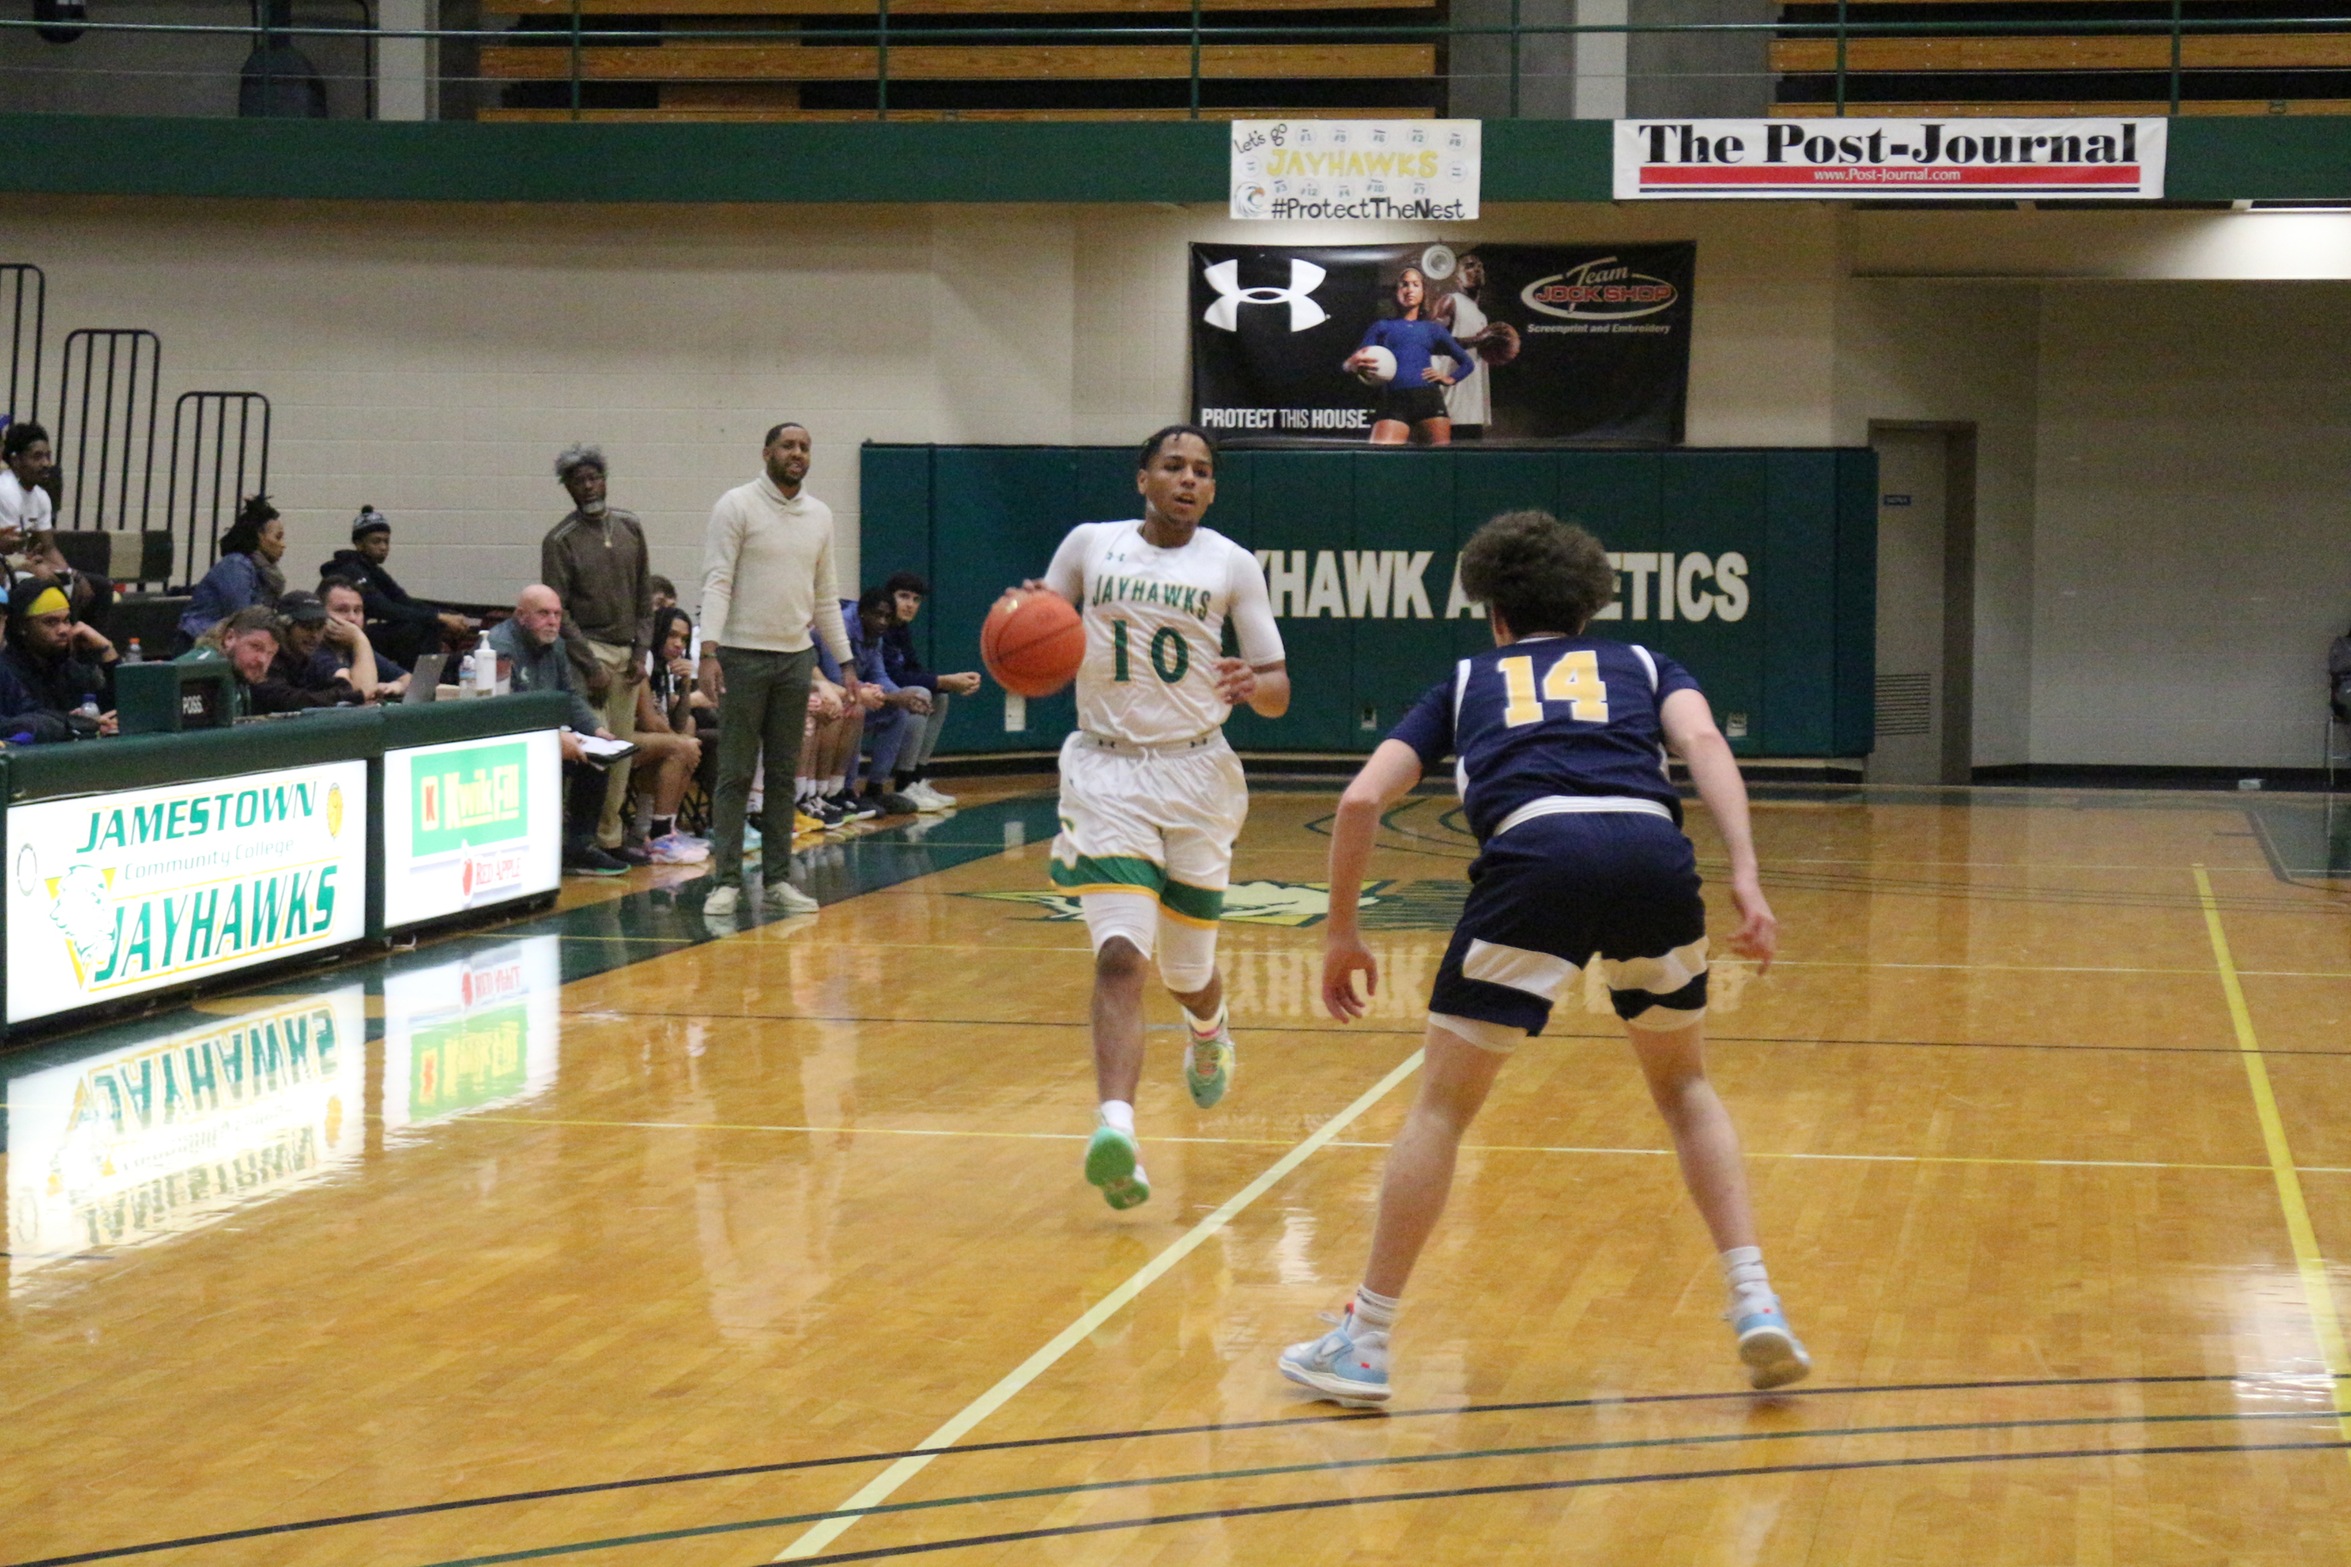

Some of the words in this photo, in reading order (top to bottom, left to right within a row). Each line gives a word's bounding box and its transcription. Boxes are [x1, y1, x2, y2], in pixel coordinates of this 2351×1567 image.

[1270, 123, 1288, 147] go
[1638, 123, 1745, 164] The
[1762, 122, 2139, 164] Post-Journal
[1266, 148, 1439, 179] JAYHAWKS
[1813, 168, 1961, 182] www.Post-Journal.com
[1271, 196, 1465, 219] #ProtectTheNest
[1566, 256, 1629, 288] Team
[1534, 284, 1602, 303] JOCK
[1603, 284, 1672, 303] SHOP
[1527, 323, 1588, 335] Screenprint
[1589, 323, 1610, 334] and
[1611, 323, 1671, 335] Embroidery
[1201, 407, 1277, 429] PROTECT
[1279, 408, 1309, 429] THIS
[1092, 574, 1212, 621] JAYHAWKS
[1254, 549, 1434, 618] HAWK
[1111, 619, 1190, 684] 10
[1497, 649, 1609, 729] 14
[76, 781, 317, 854] JAMESTOWN
[124, 851, 230, 881] Community
[234, 839, 294, 860] College
[94, 865, 338, 983] JAYHAWKS
